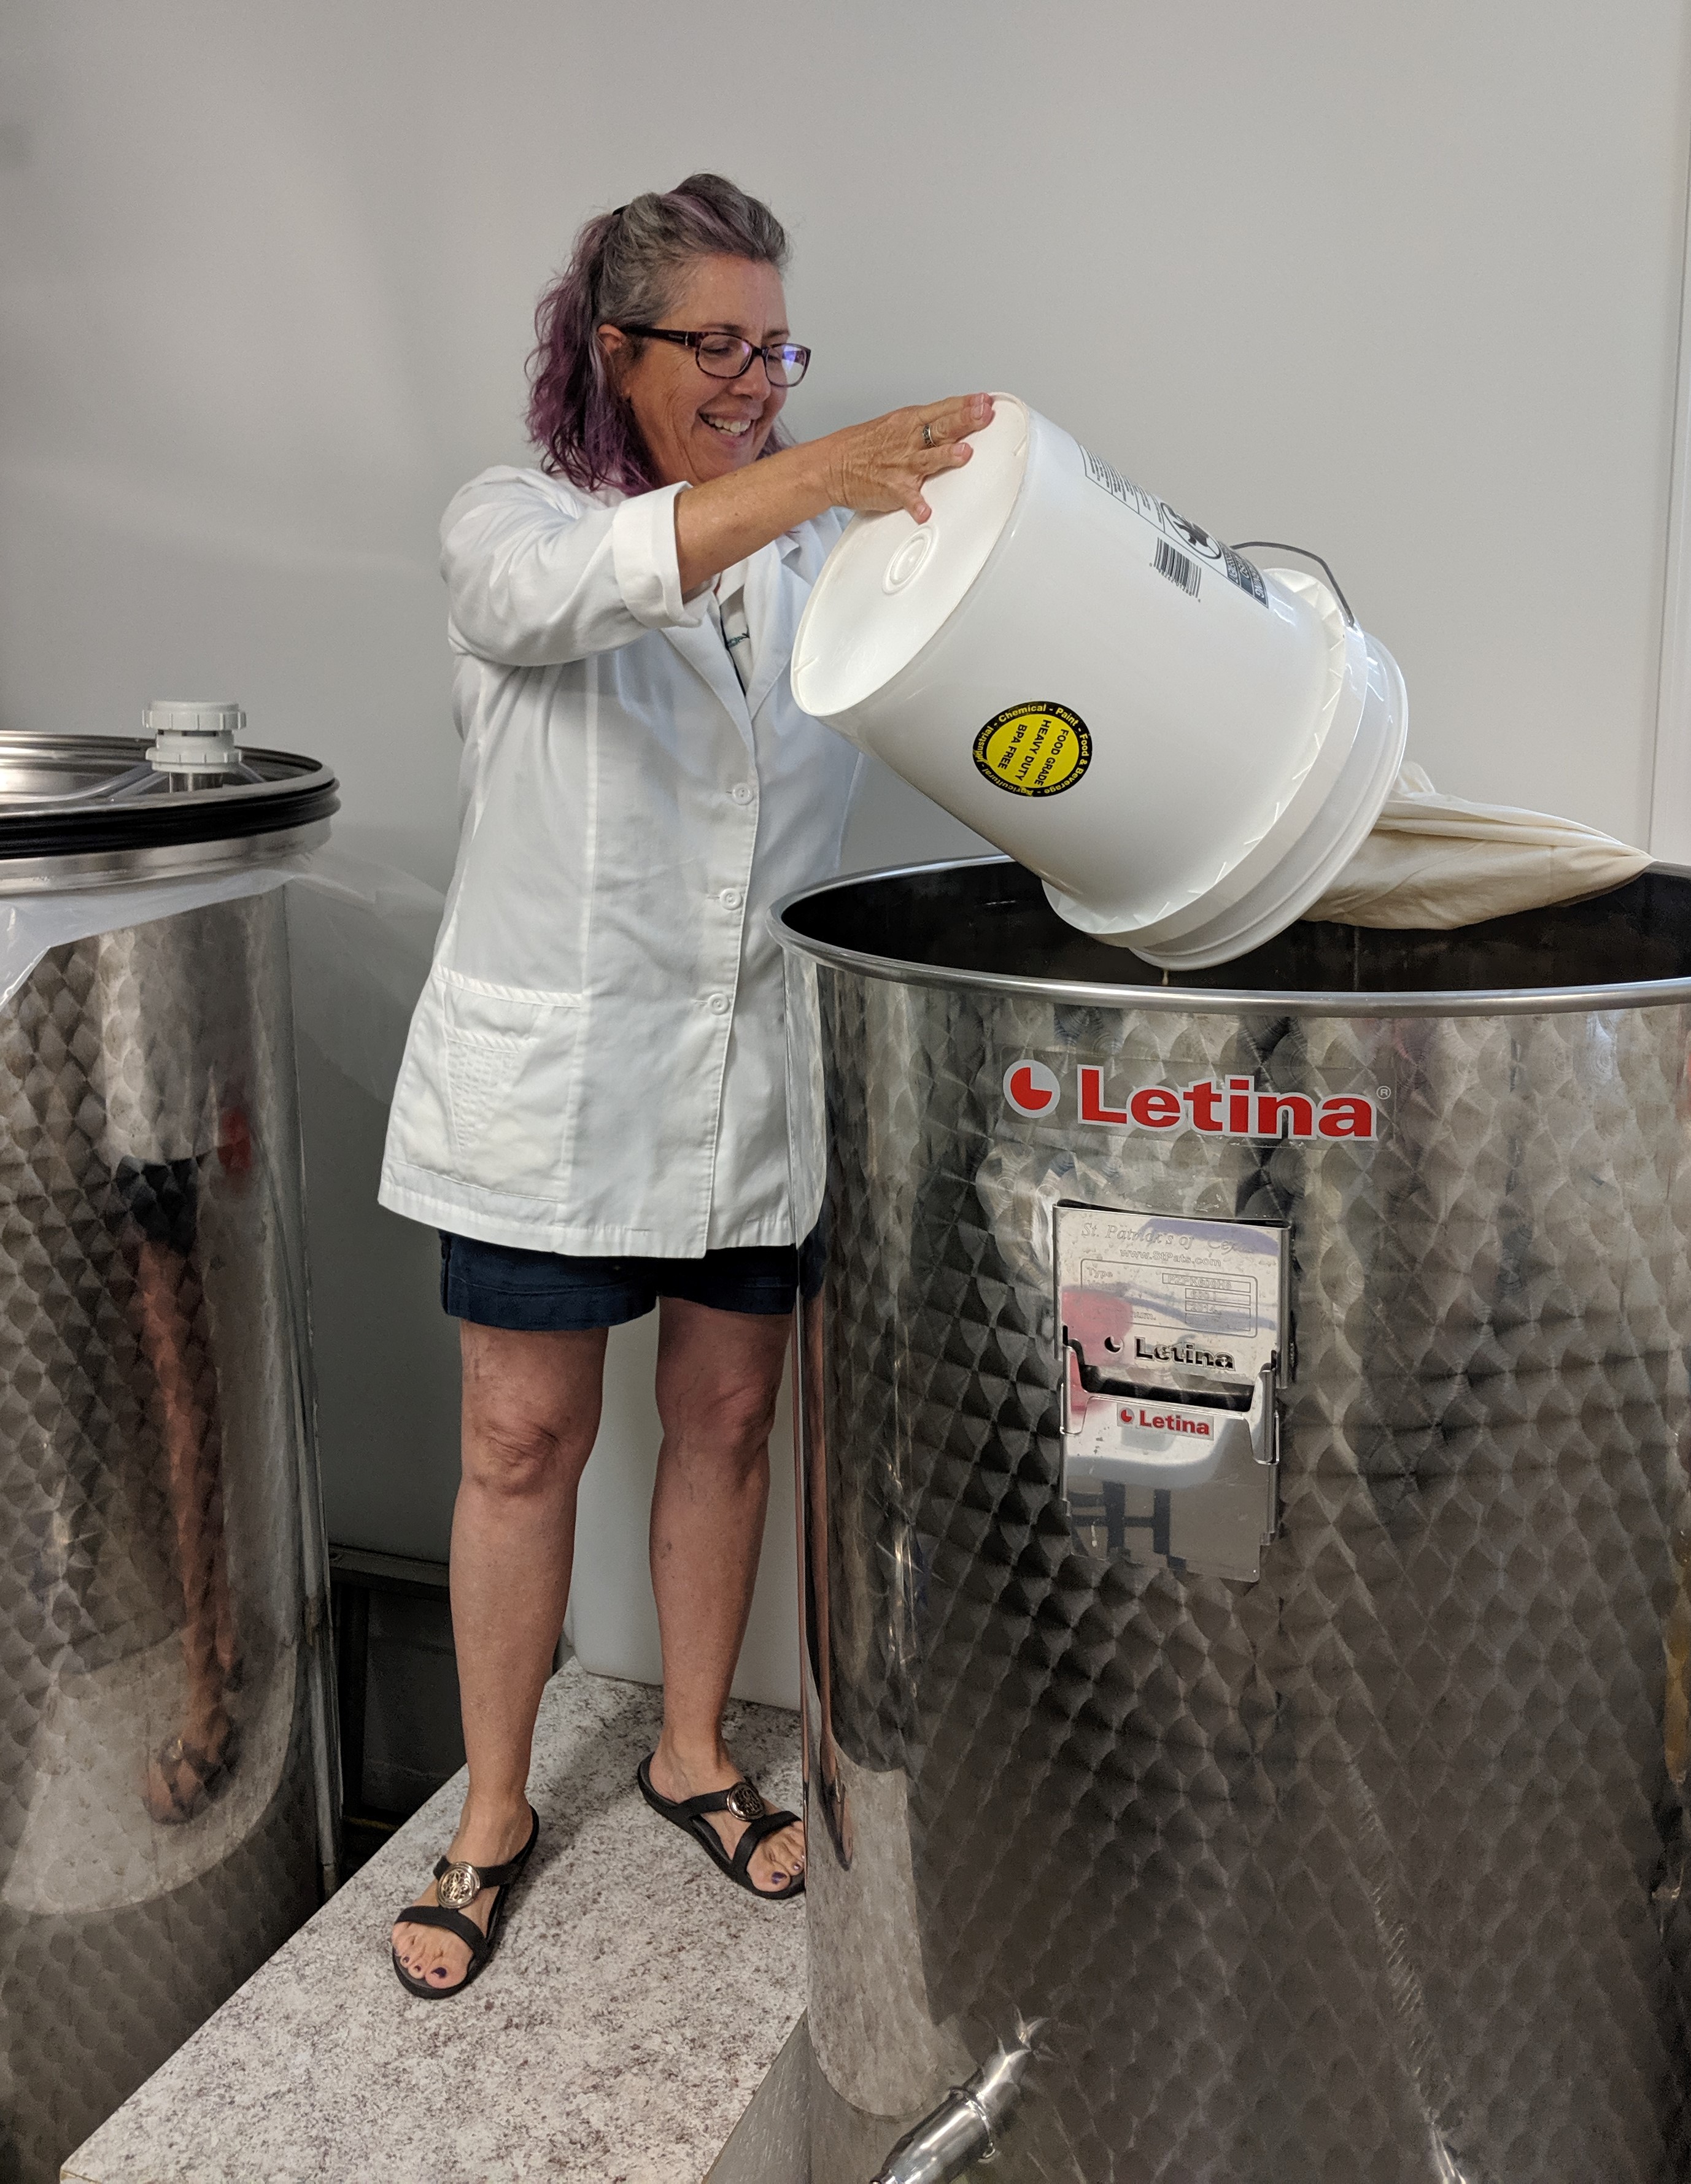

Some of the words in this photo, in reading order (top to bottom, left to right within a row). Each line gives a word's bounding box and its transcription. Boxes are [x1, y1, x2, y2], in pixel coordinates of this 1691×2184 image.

[998, 704, 1047, 722] Chemical
[1055, 707, 1079, 727] Paint
[976, 725, 994, 762] Industrial
[1010, 723, 1028, 744] BPA
[1029, 719, 1052, 755] HEAVY
[1050, 728, 1070, 755] FOOD
[1079, 733, 1089, 757] Food
[997, 745, 1018, 770] FREE
[1014, 755, 1035, 781] DUTY
[981, 768, 1034, 796] Agricultural
[1034, 757, 1056, 786] GRADE
[1043, 767, 1085, 794] Beverage
[1078, 1065, 1376, 1140] Letina
[1081, 1222, 1100, 1237] St.
[1119, 1248, 1221, 1267] www.StPats.com
[1086, 1266, 1113, 1279] Type
[1134, 1335, 1236, 1372] Letina
[1139, 1410, 1210, 1436] Letina
